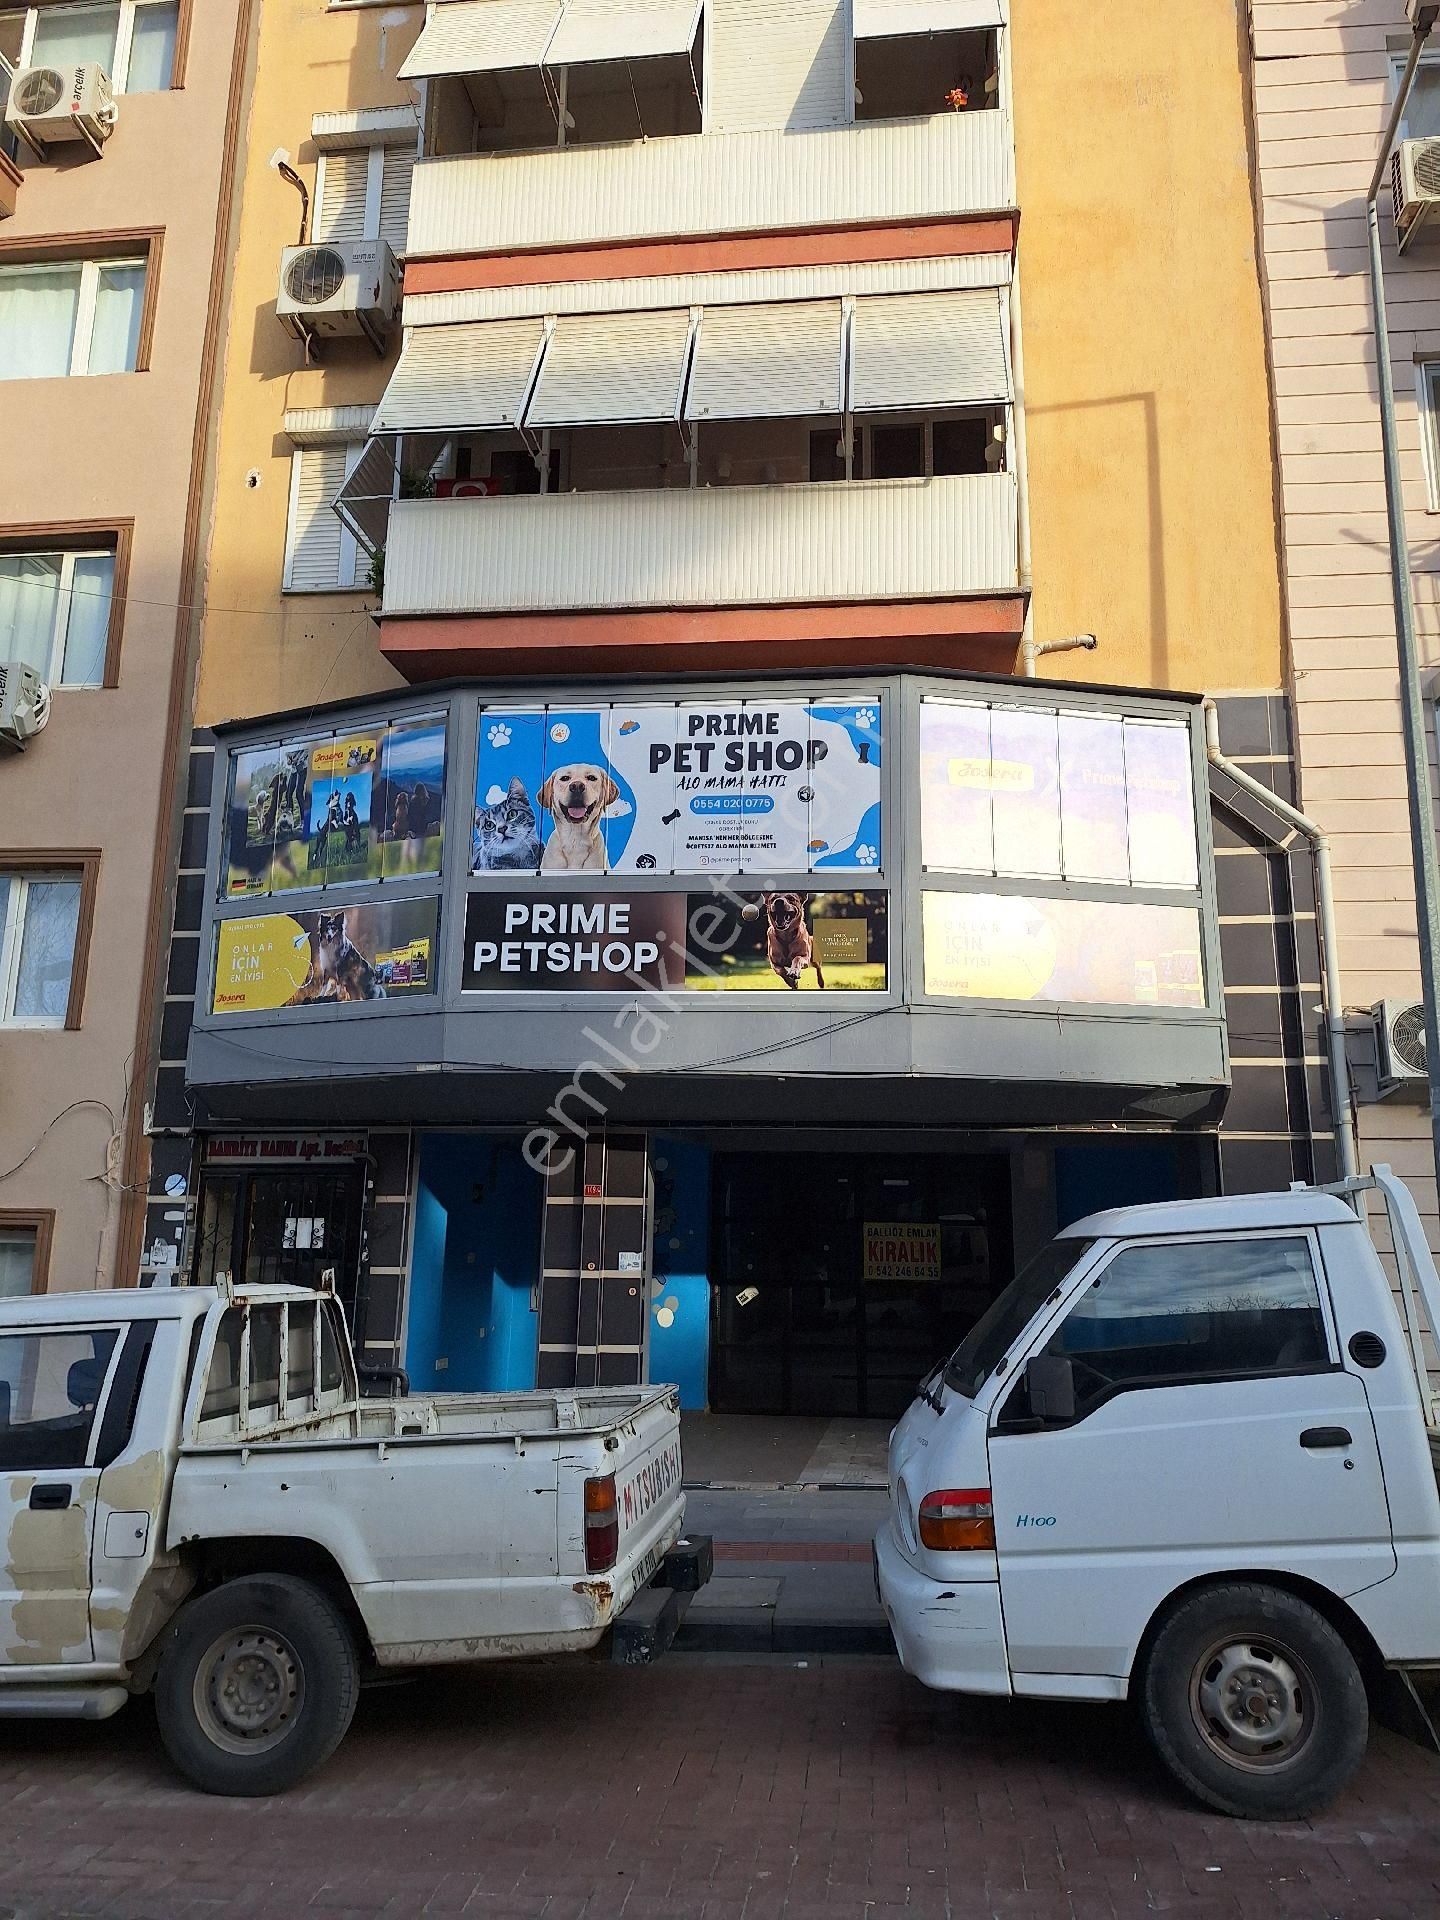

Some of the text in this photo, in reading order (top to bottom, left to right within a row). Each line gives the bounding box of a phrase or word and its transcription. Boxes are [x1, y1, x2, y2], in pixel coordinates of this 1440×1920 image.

[689, 713, 780, 737] PRIME
[650, 739, 828, 773] PET SHOP
[677, 776, 701, 790] ALO
[705, 777, 745, 789] MAMA
[693, 797, 771, 809] 0554 020 0775
[504, 903, 631, 935] PRIME
[232, 943, 273, 955] ONLAR
[473, 941, 659, 973] PETSHOP
[876, 1266, 892, 1276] 542
[895, 1266, 912, 1277] 246
[1016, 1513, 1057, 1528] H100
